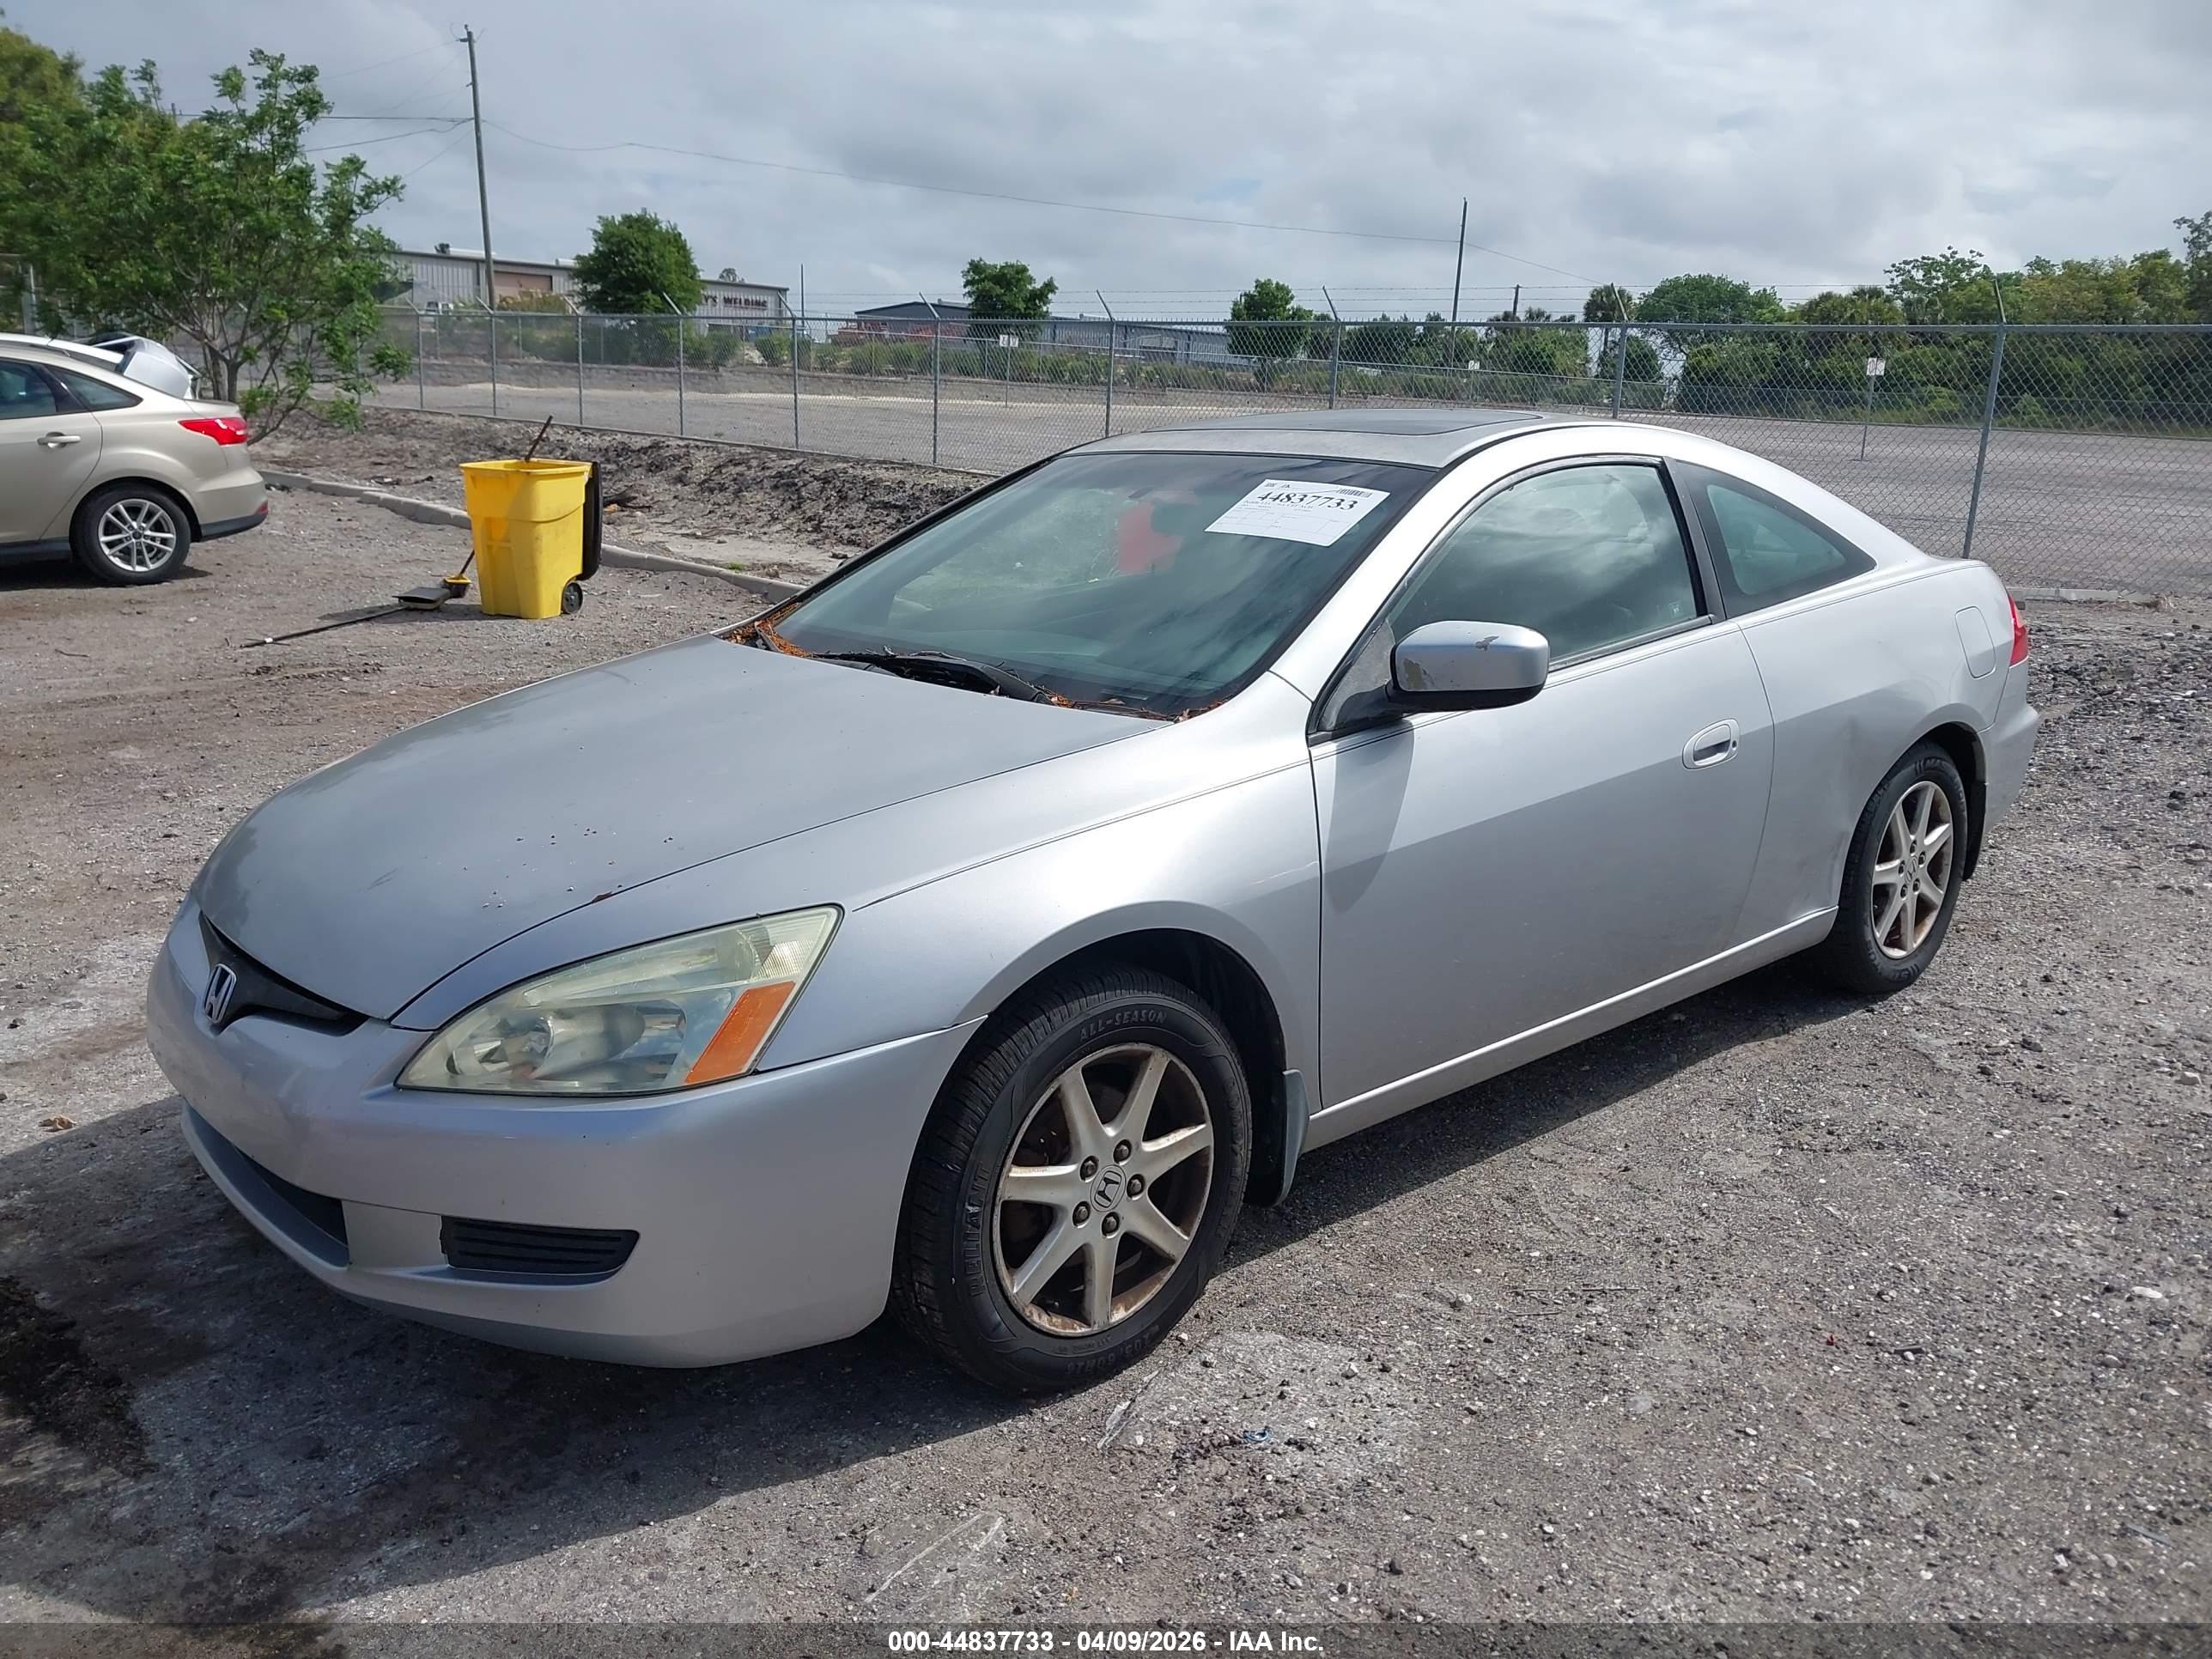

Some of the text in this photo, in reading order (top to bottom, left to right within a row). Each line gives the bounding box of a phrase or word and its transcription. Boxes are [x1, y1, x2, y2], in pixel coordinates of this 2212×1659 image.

[723, 295, 767, 307] WELDING
[1257, 491, 1358, 510] 44837733
[1079, 1009, 1168, 1043] ALL-SEASON
[962, 1159, 991, 1299] RELIANT
